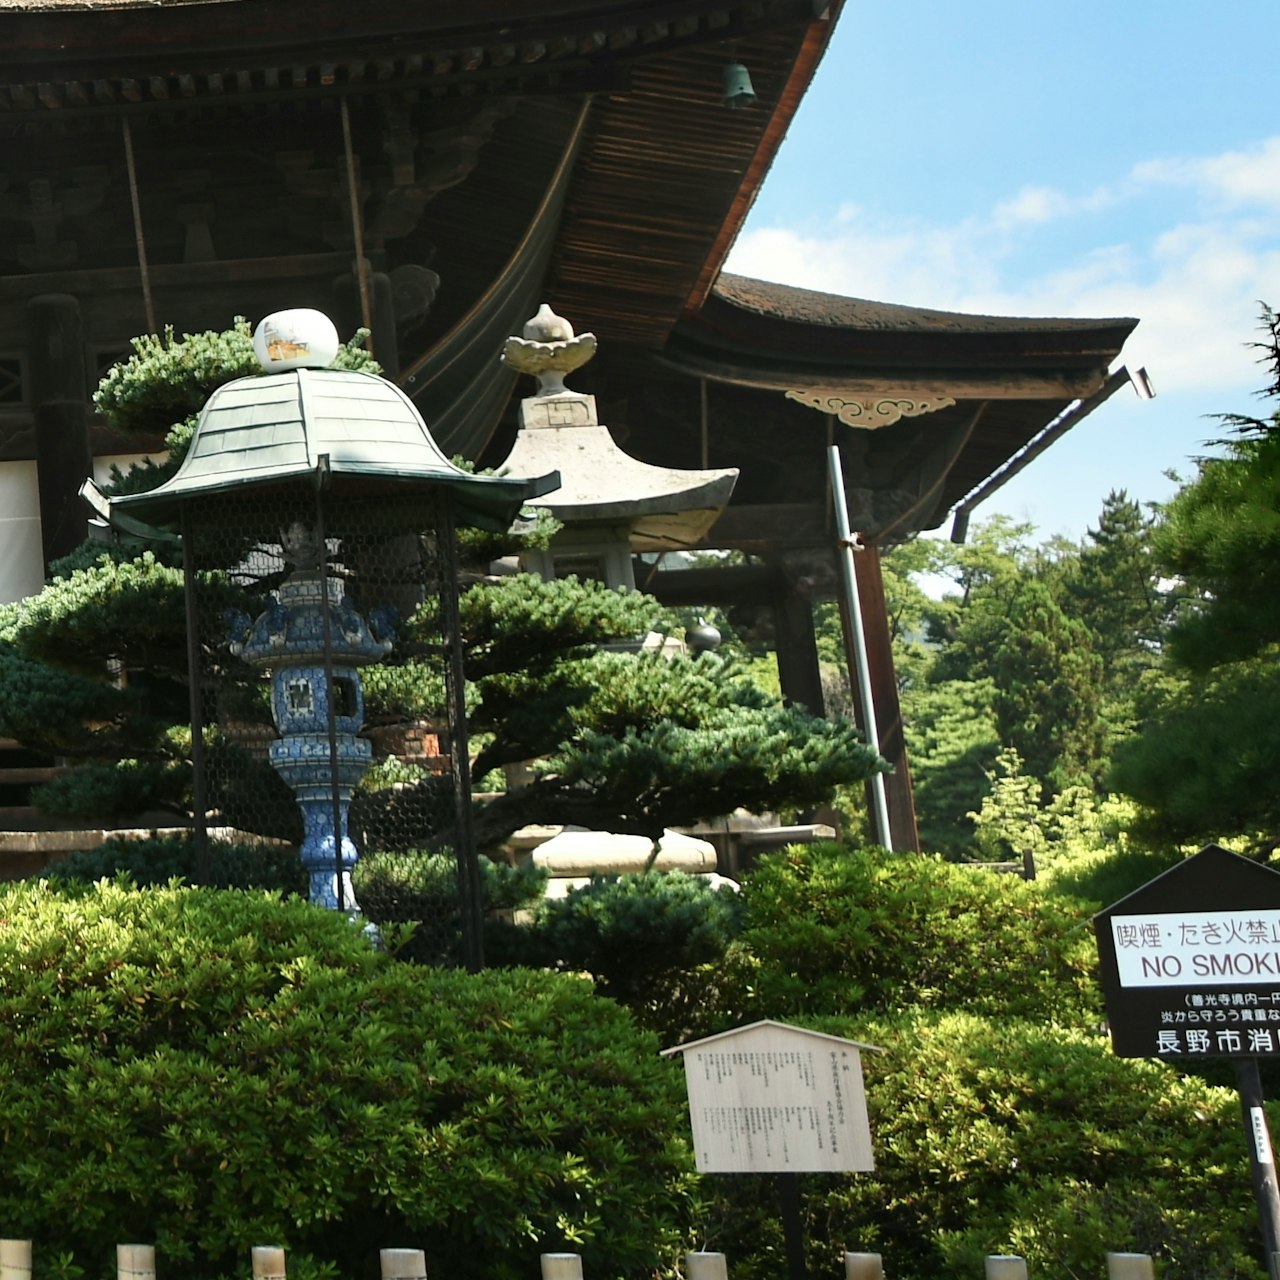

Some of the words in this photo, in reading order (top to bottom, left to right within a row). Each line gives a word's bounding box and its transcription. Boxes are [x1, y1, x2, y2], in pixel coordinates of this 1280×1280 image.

[1141, 955, 1182, 978] NO
[1156, 1027, 1280, 1054] 長野市消
